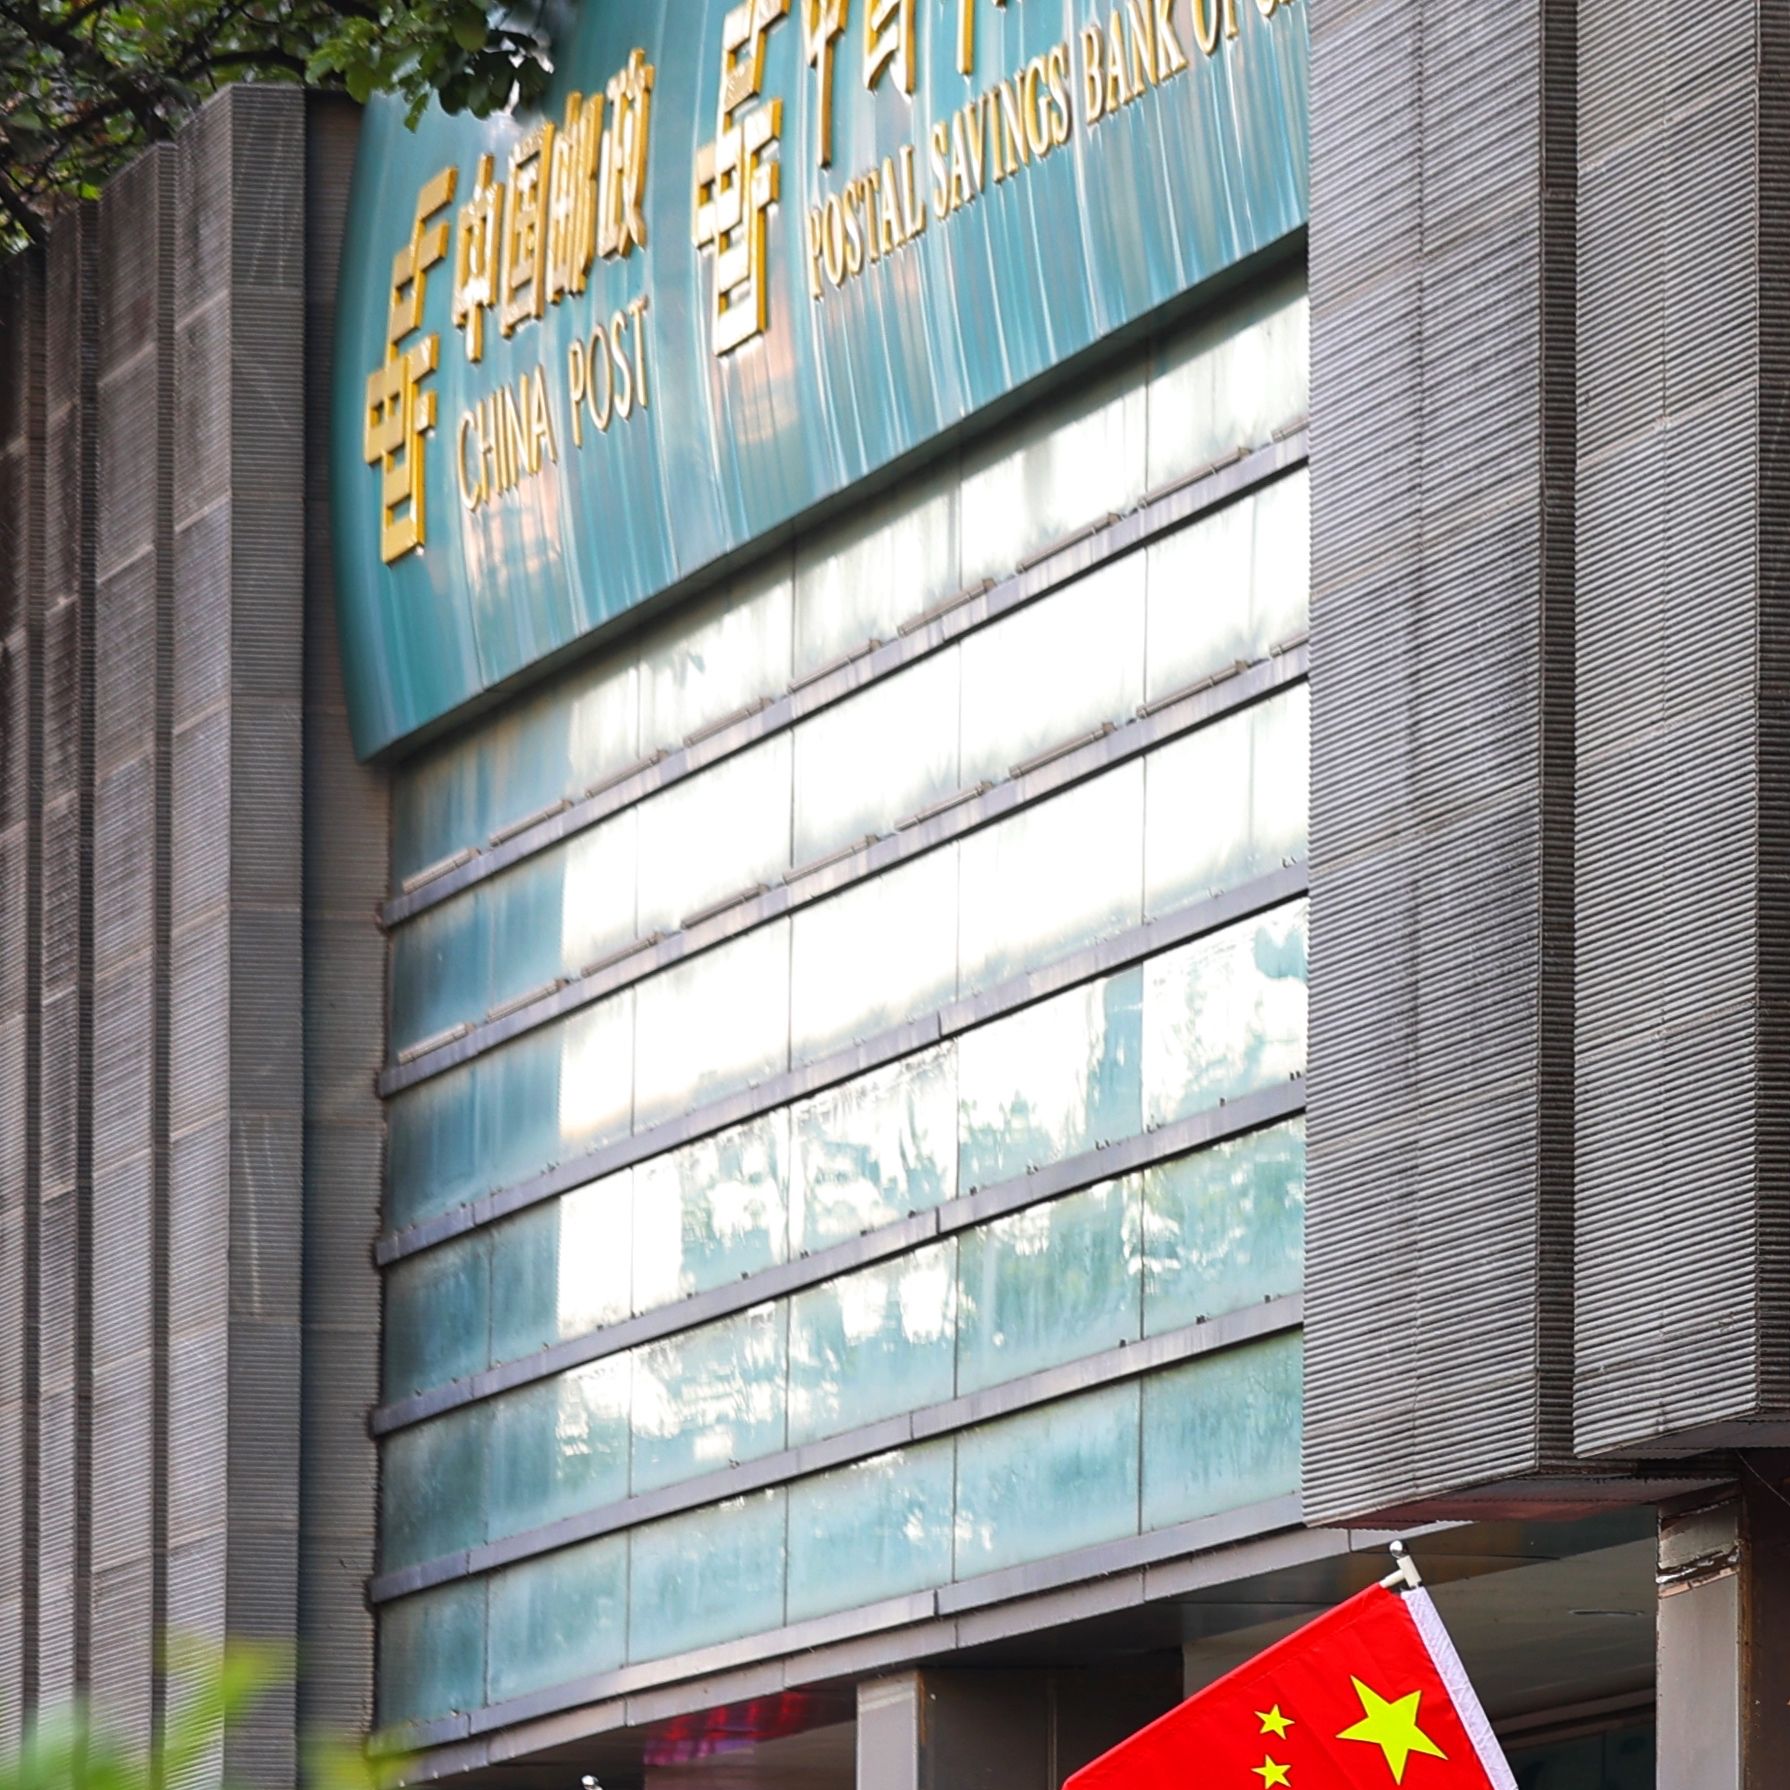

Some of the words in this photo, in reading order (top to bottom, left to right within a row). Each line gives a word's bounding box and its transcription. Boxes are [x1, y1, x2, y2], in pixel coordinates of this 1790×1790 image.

[452, 47, 656, 363] 中国邮政
[806, 145, 926, 300] POSTAL
[930, 43, 1072, 220] SAVINGS
[1080, 0, 1191, 126] BANK
[457, 364, 560, 513] CHINA
[567, 296, 651, 447] POST
